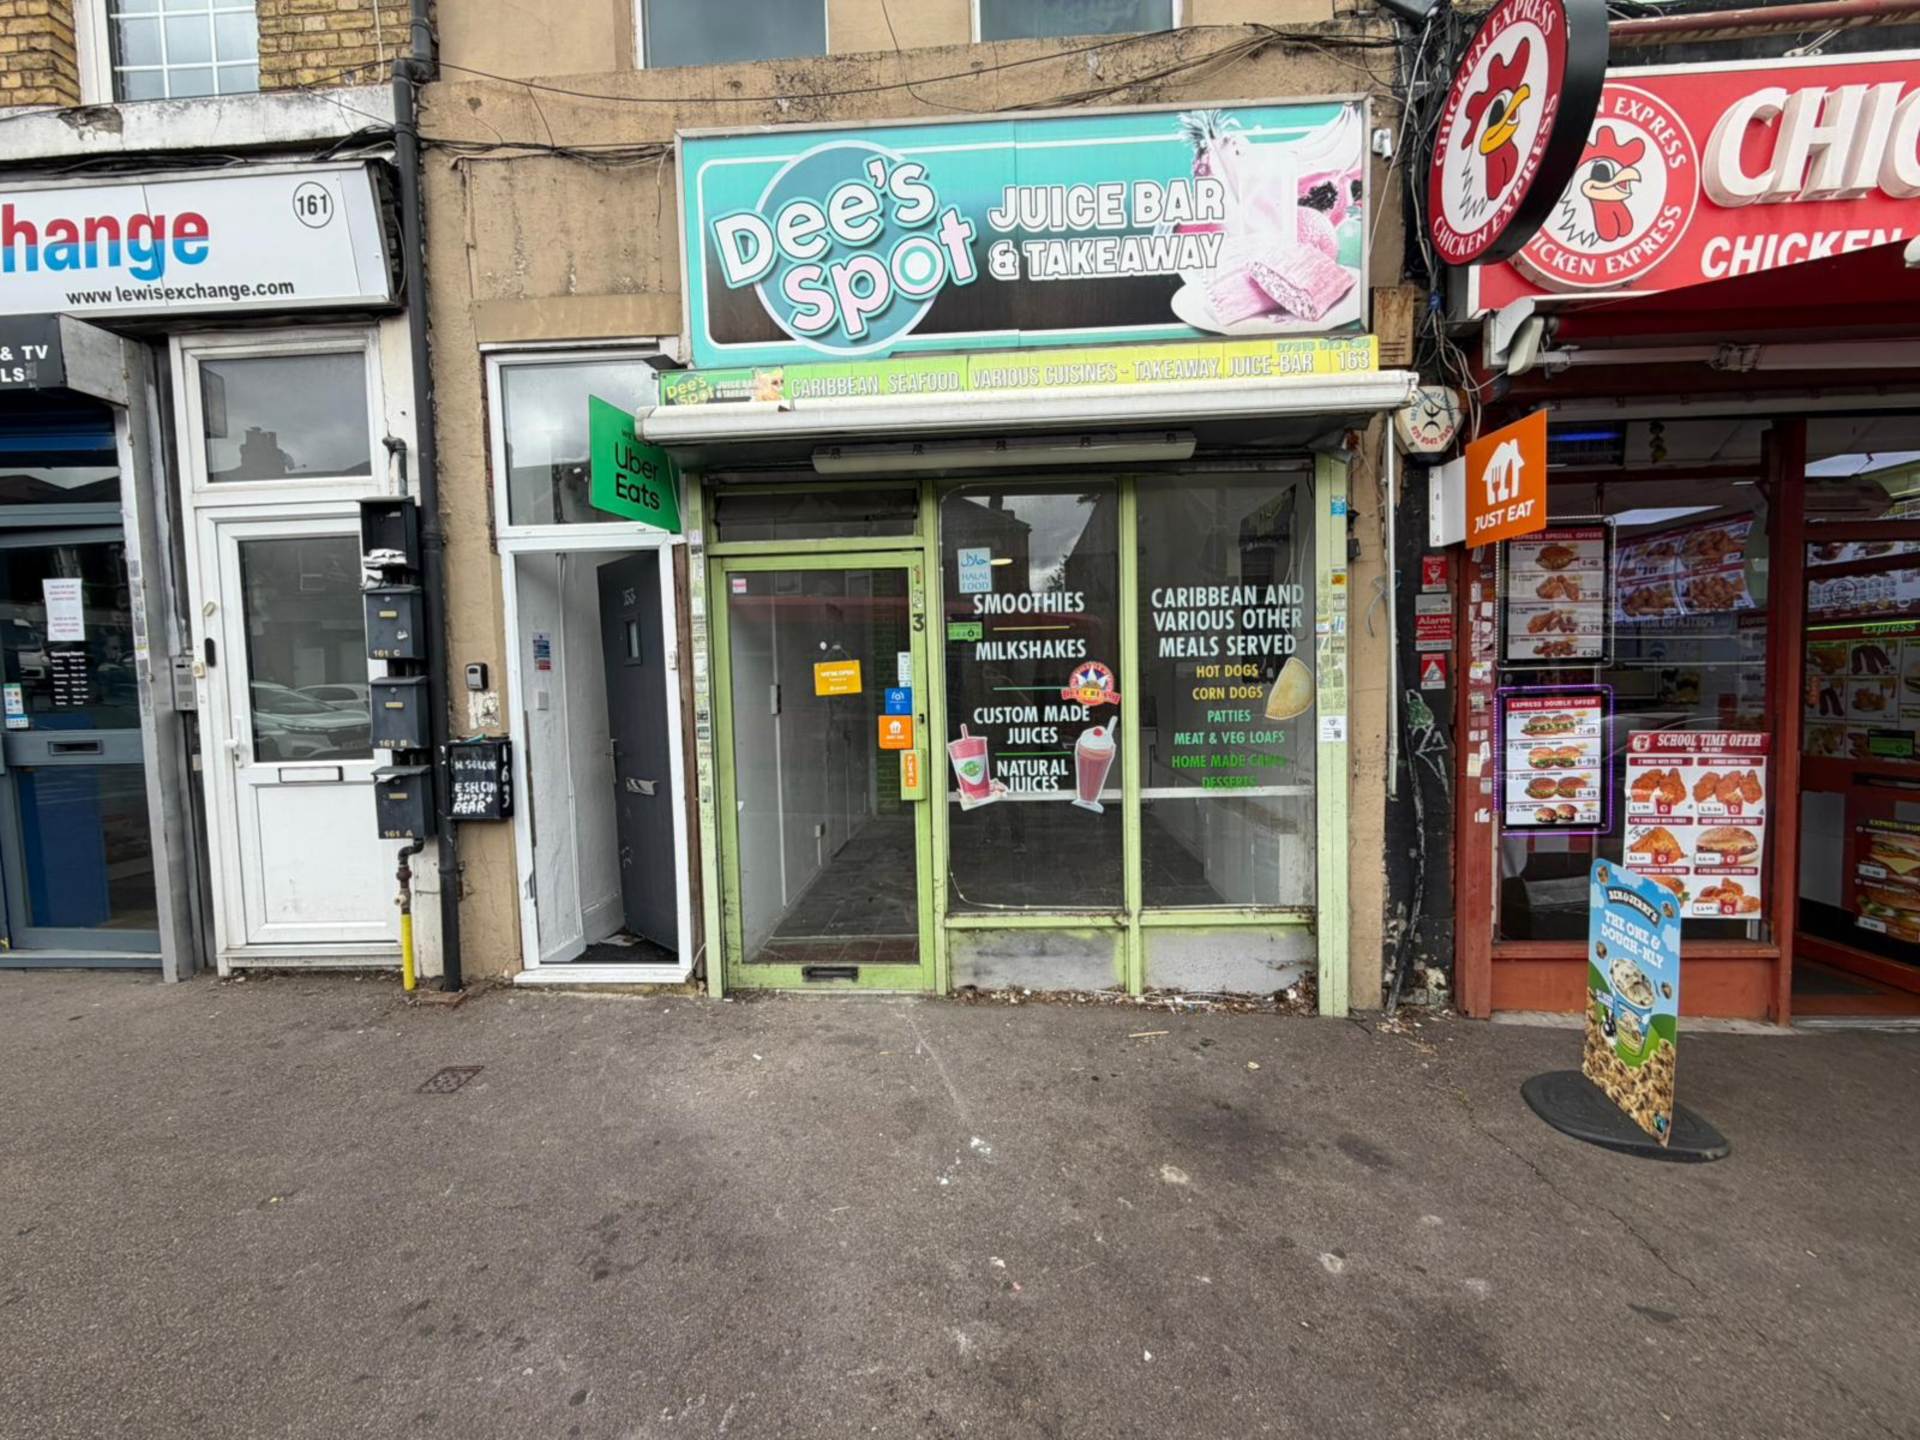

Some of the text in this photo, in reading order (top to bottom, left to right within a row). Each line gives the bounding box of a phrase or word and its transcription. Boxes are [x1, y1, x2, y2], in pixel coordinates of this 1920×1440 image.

[1614, 97, 1688, 170] EXPRESS
[295, 193, 329, 218] 161
[988, 178, 1225, 230] JUICE BAR
[712, 157, 937, 286] Dee's
[1433, 216, 1488, 257] CHICKEN
[1605, 204, 1683, 275] EXPRESS
[989, 233, 1224, 278] & TAKEAWAY
[21, 344, 49, 360] TV
[1338, 350, 1370, 370] 163
[791, 376, 880, 399] CARIBBEAN
[973, 364, 1039, 389] VARIOUS
[1044, 361, 1118, 385] CUISINES
[615, 441, 659, 482] Uber
[616, 473, 661, 511] Eats
[1474, 499, 1536, 535] JUST EAT
[962, 571, 988, 580] HALAL
[962, 582, 989, 591] FOOD
[1151, 584, 1305, 609] CARIBBEAN AND
[973, 592, 1085, 615] SMOOTHIES
[1152, 608, 1302, 632] VARIOUS OTHER
[1418, 616, 1451, 625] Alarm
[975, 639, 1087, 661] MILKSHAKES
[1158, 634, 1297, 658] MEALS SERVED
[1196, 663, 1259, 678] HOT DOGS
[1192, 685, 1264, 700] CORN DOGS
[1574, 698, 1597, 706] OFFER
[973, 704, 1091, 724] CUSTOM MADE
[1207, 709, 1251, 722] PATTIES
[1006, 727, 1059, 745] JUICES
[1174, 730, 1286, 745] MEAT & VEG LOAFS
[1657, 733, 1763, 748] SCHOOL TIME OFFER
[996, 759, 1069, 776] NATURAL
[1171, 755, 1207, 768] HOME
[1210, 754, 1246, 768] MADE
[1006, 776, 1059, 793] JUICES
[452, 801, 486, 814] REAR
[1604, 909, 1661, 951] THE ONE &
